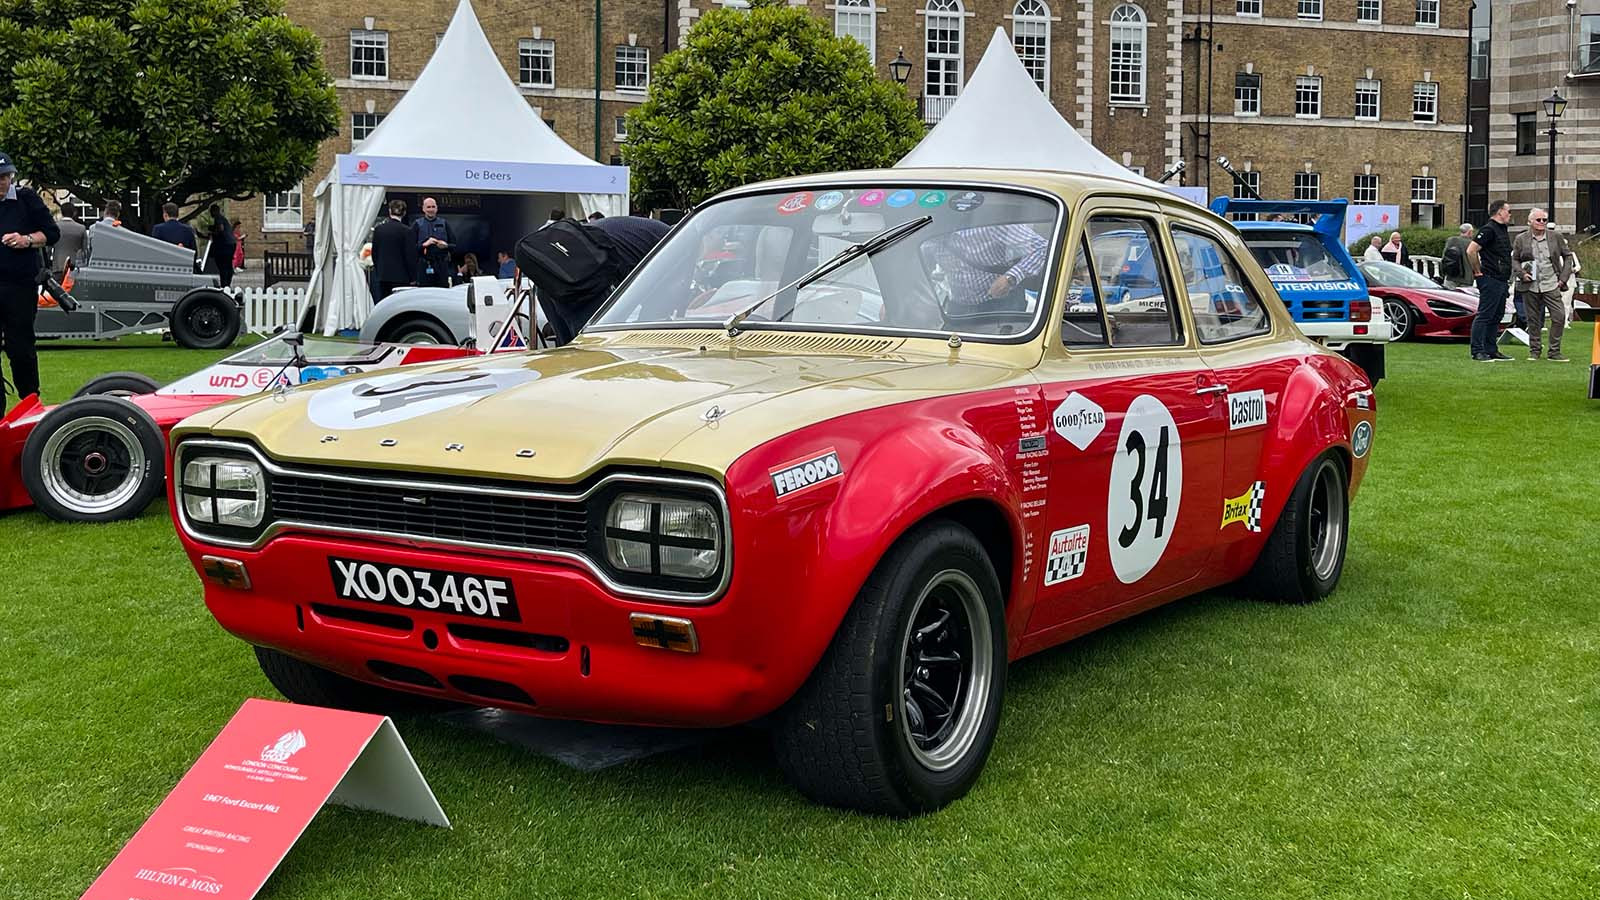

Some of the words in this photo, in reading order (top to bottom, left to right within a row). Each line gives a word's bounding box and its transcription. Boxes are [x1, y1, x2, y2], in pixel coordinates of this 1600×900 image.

[465, 170, 480, 179] De
[483, 170, 511, 181] Beers
[610, 176, 617, 184] 2
[1231, 394, 1263, 425] Castrol
[774, 456, 839, 494] FERODO
[1118, 425, 1169, 548] 34
[1225, 502, 1248, 520] Britax
[1052, 532, 1087, 556] Autolite
[335, 559, 509, 617] XOO346F
[242, 760, 266, 769] LONDON
[203, 793, 222, 802] 1967
[222, 796, 241, 805] Ford
[240, 800, 263, 810] Escort
[226, 833, 251, 843] RACING
[136, 869, 180, 886] HILTON
[179, 878, 189, 887] &
[187, 879, 223, 894] MOSS
